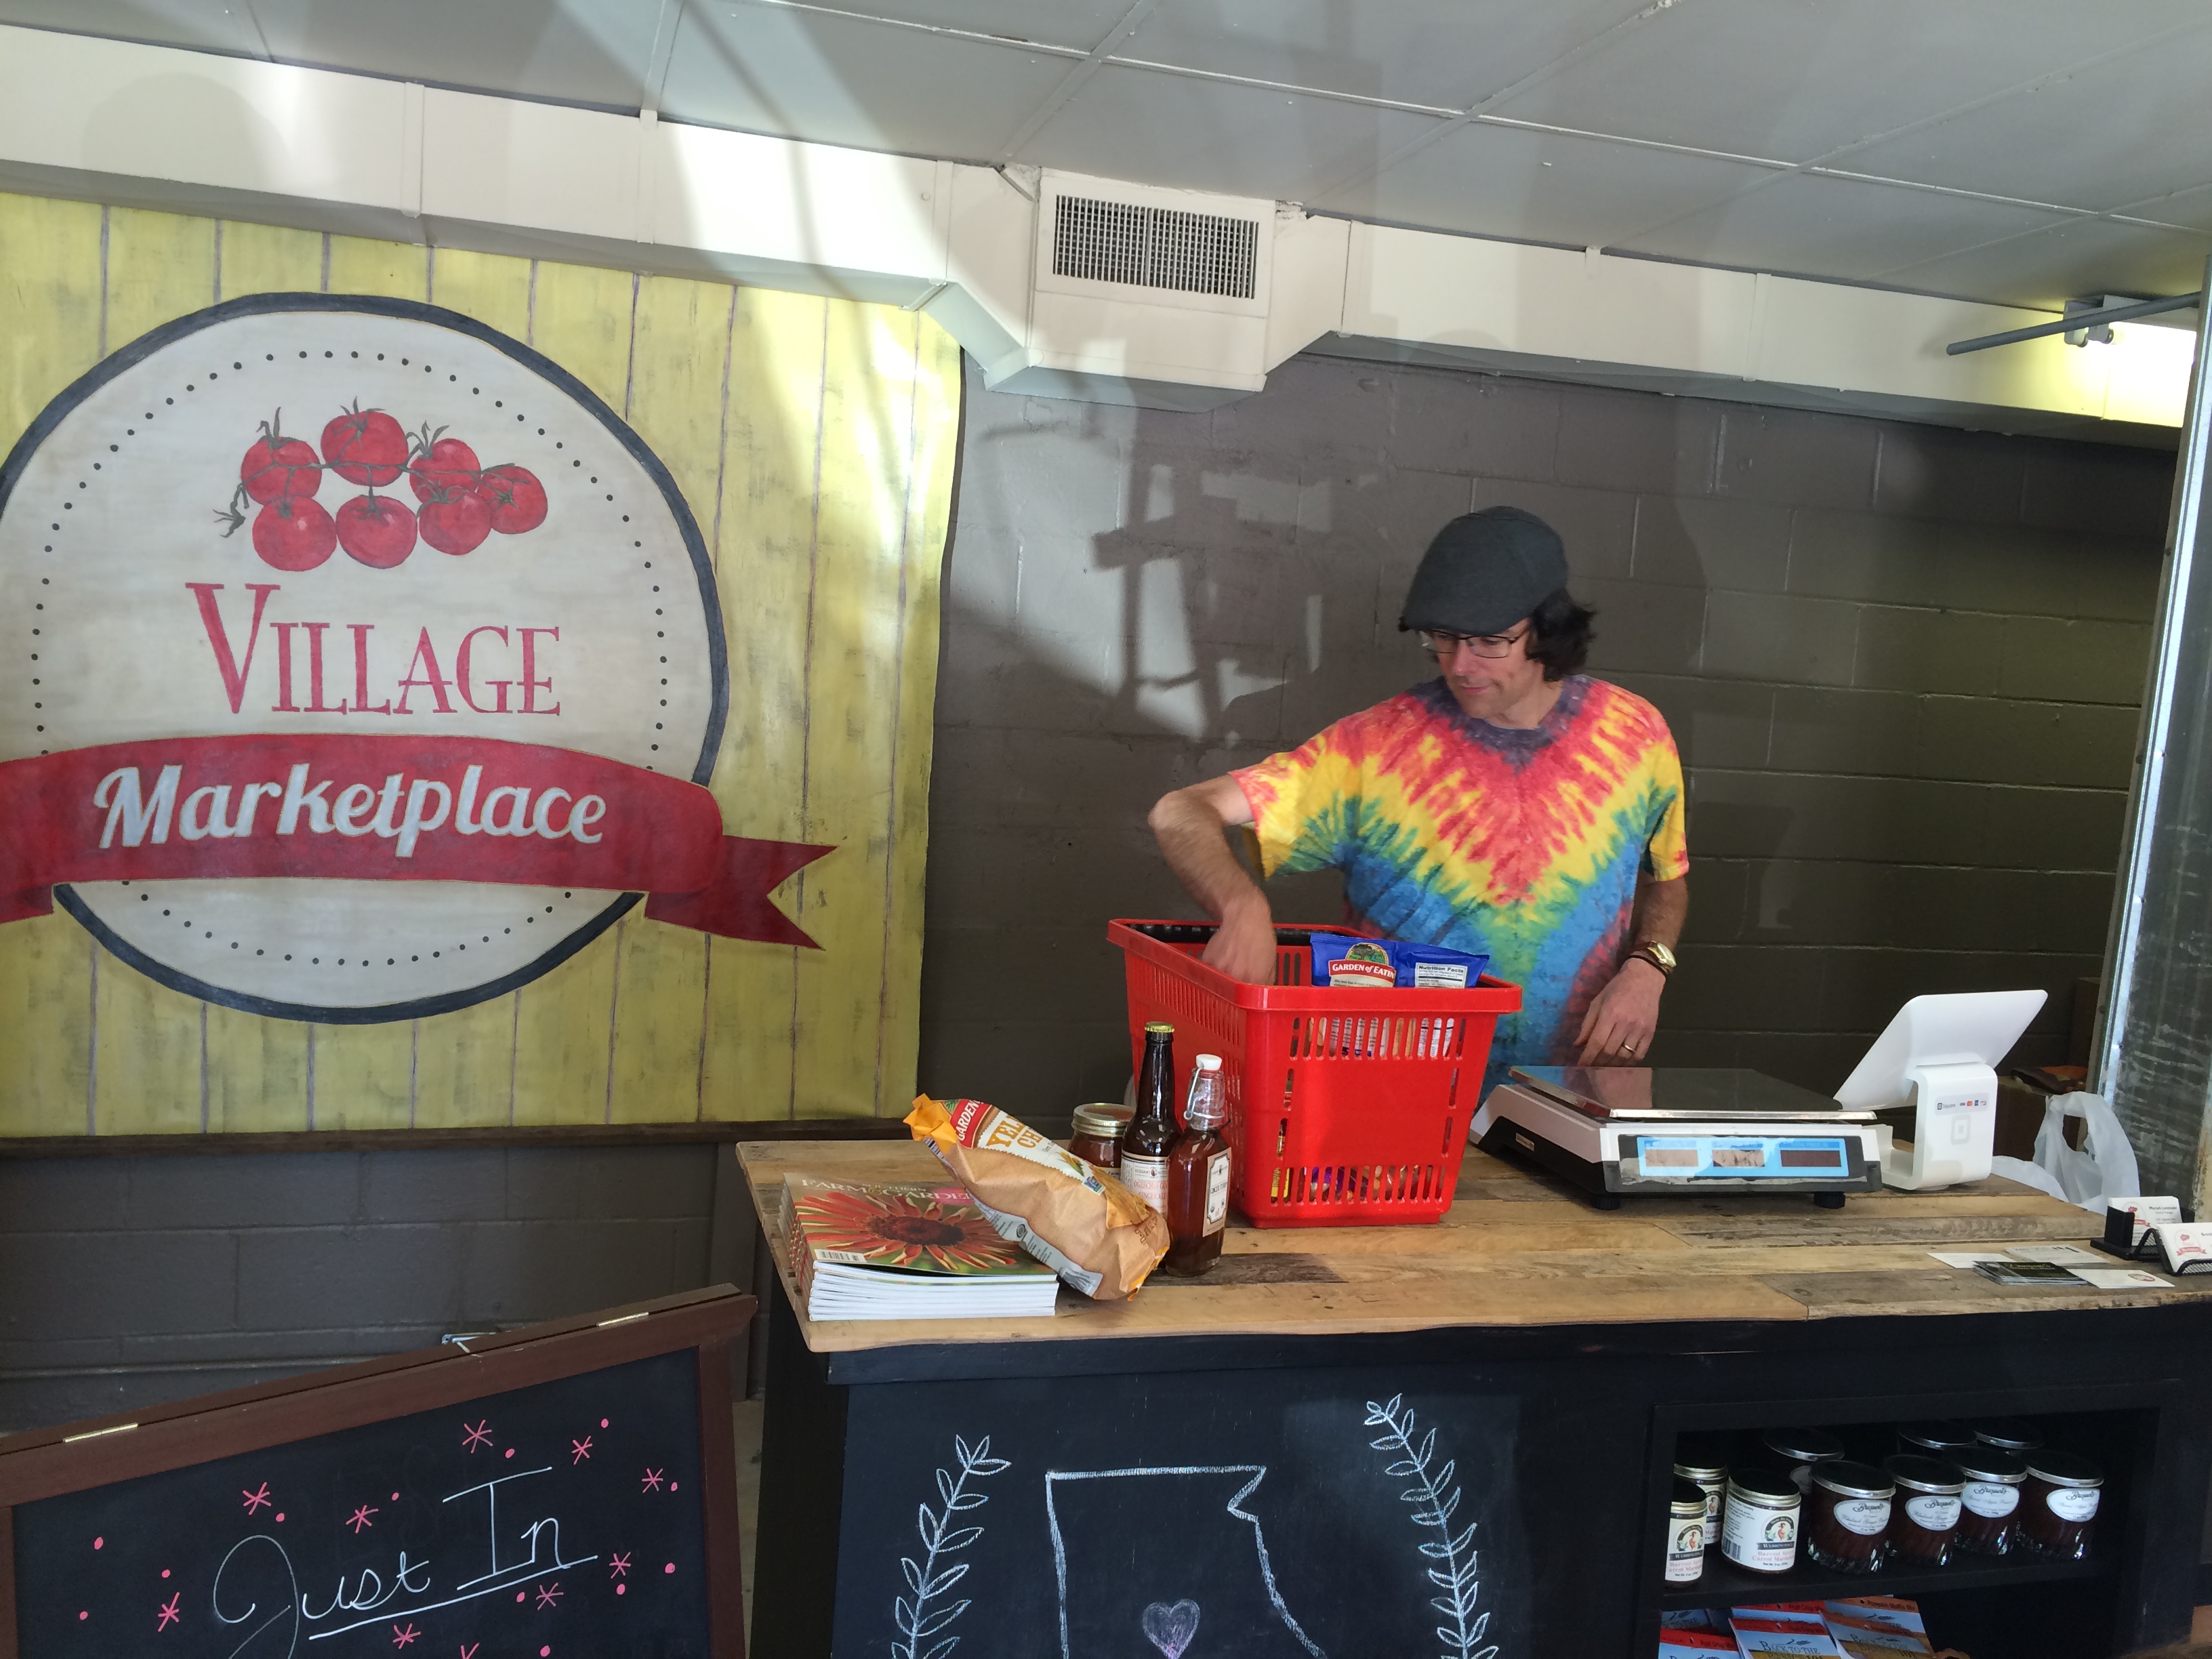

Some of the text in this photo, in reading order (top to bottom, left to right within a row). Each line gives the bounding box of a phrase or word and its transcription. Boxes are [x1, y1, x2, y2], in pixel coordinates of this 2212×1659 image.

[185, 582, 560, 716] VILLAGE
[93, 762, 607, 857] Marketplace
[1332, 963, 1364, 972] GARDEN
[1365, 965, 1374, 973] of
[802, 1179, 867, 1193] FARM
[213, 1466, 571, 1659] Just In
[1759, 1641, 1789, 1653] BACK
